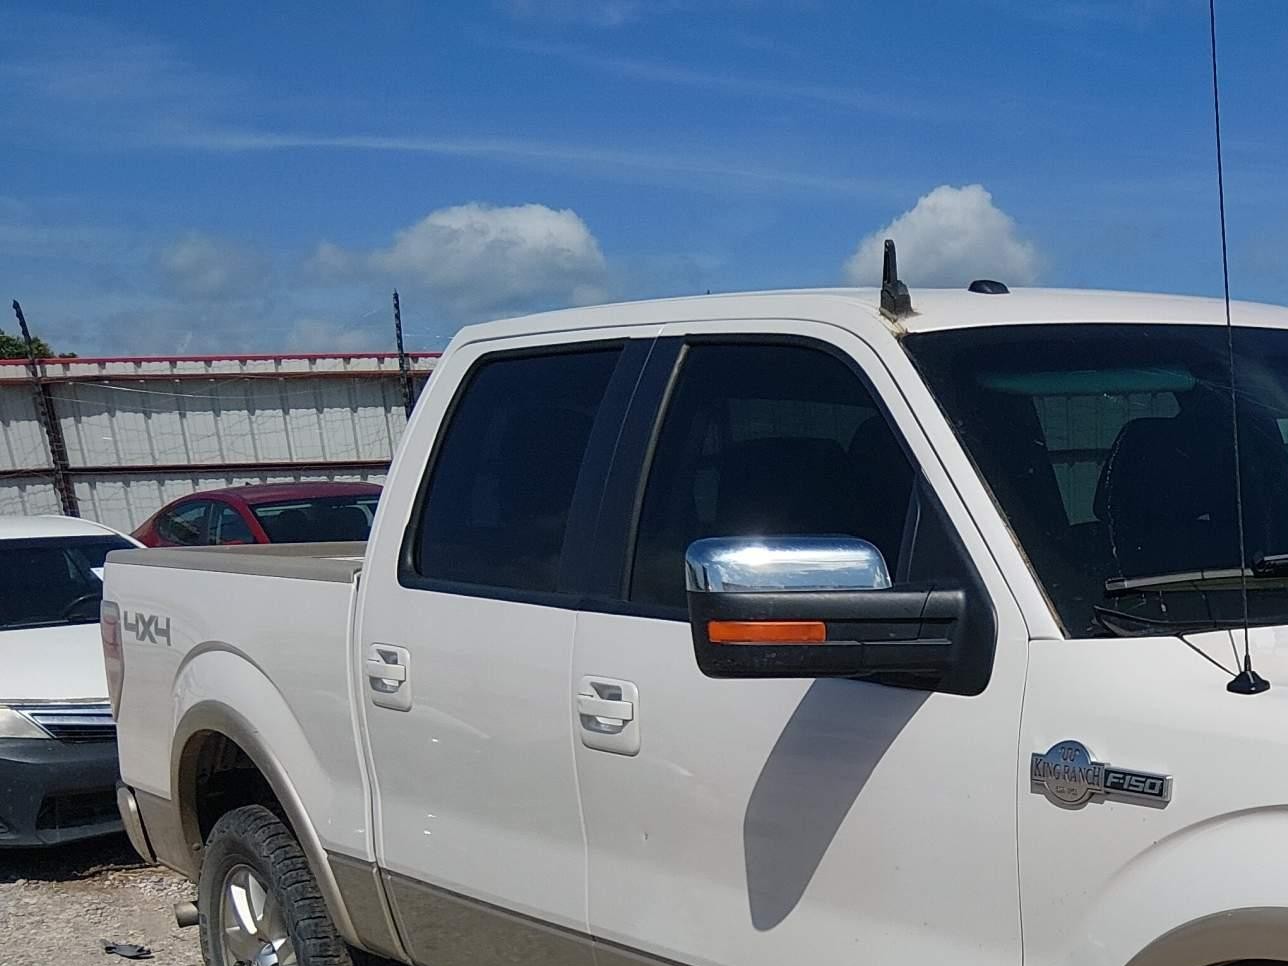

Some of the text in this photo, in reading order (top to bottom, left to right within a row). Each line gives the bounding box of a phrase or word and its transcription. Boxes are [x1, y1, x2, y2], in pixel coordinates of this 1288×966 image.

[123, 610, 172, 647] 4X4
[1033, 757, 1101, 788] KING RANCH
[1107, 773, 1163, 794] F-150
